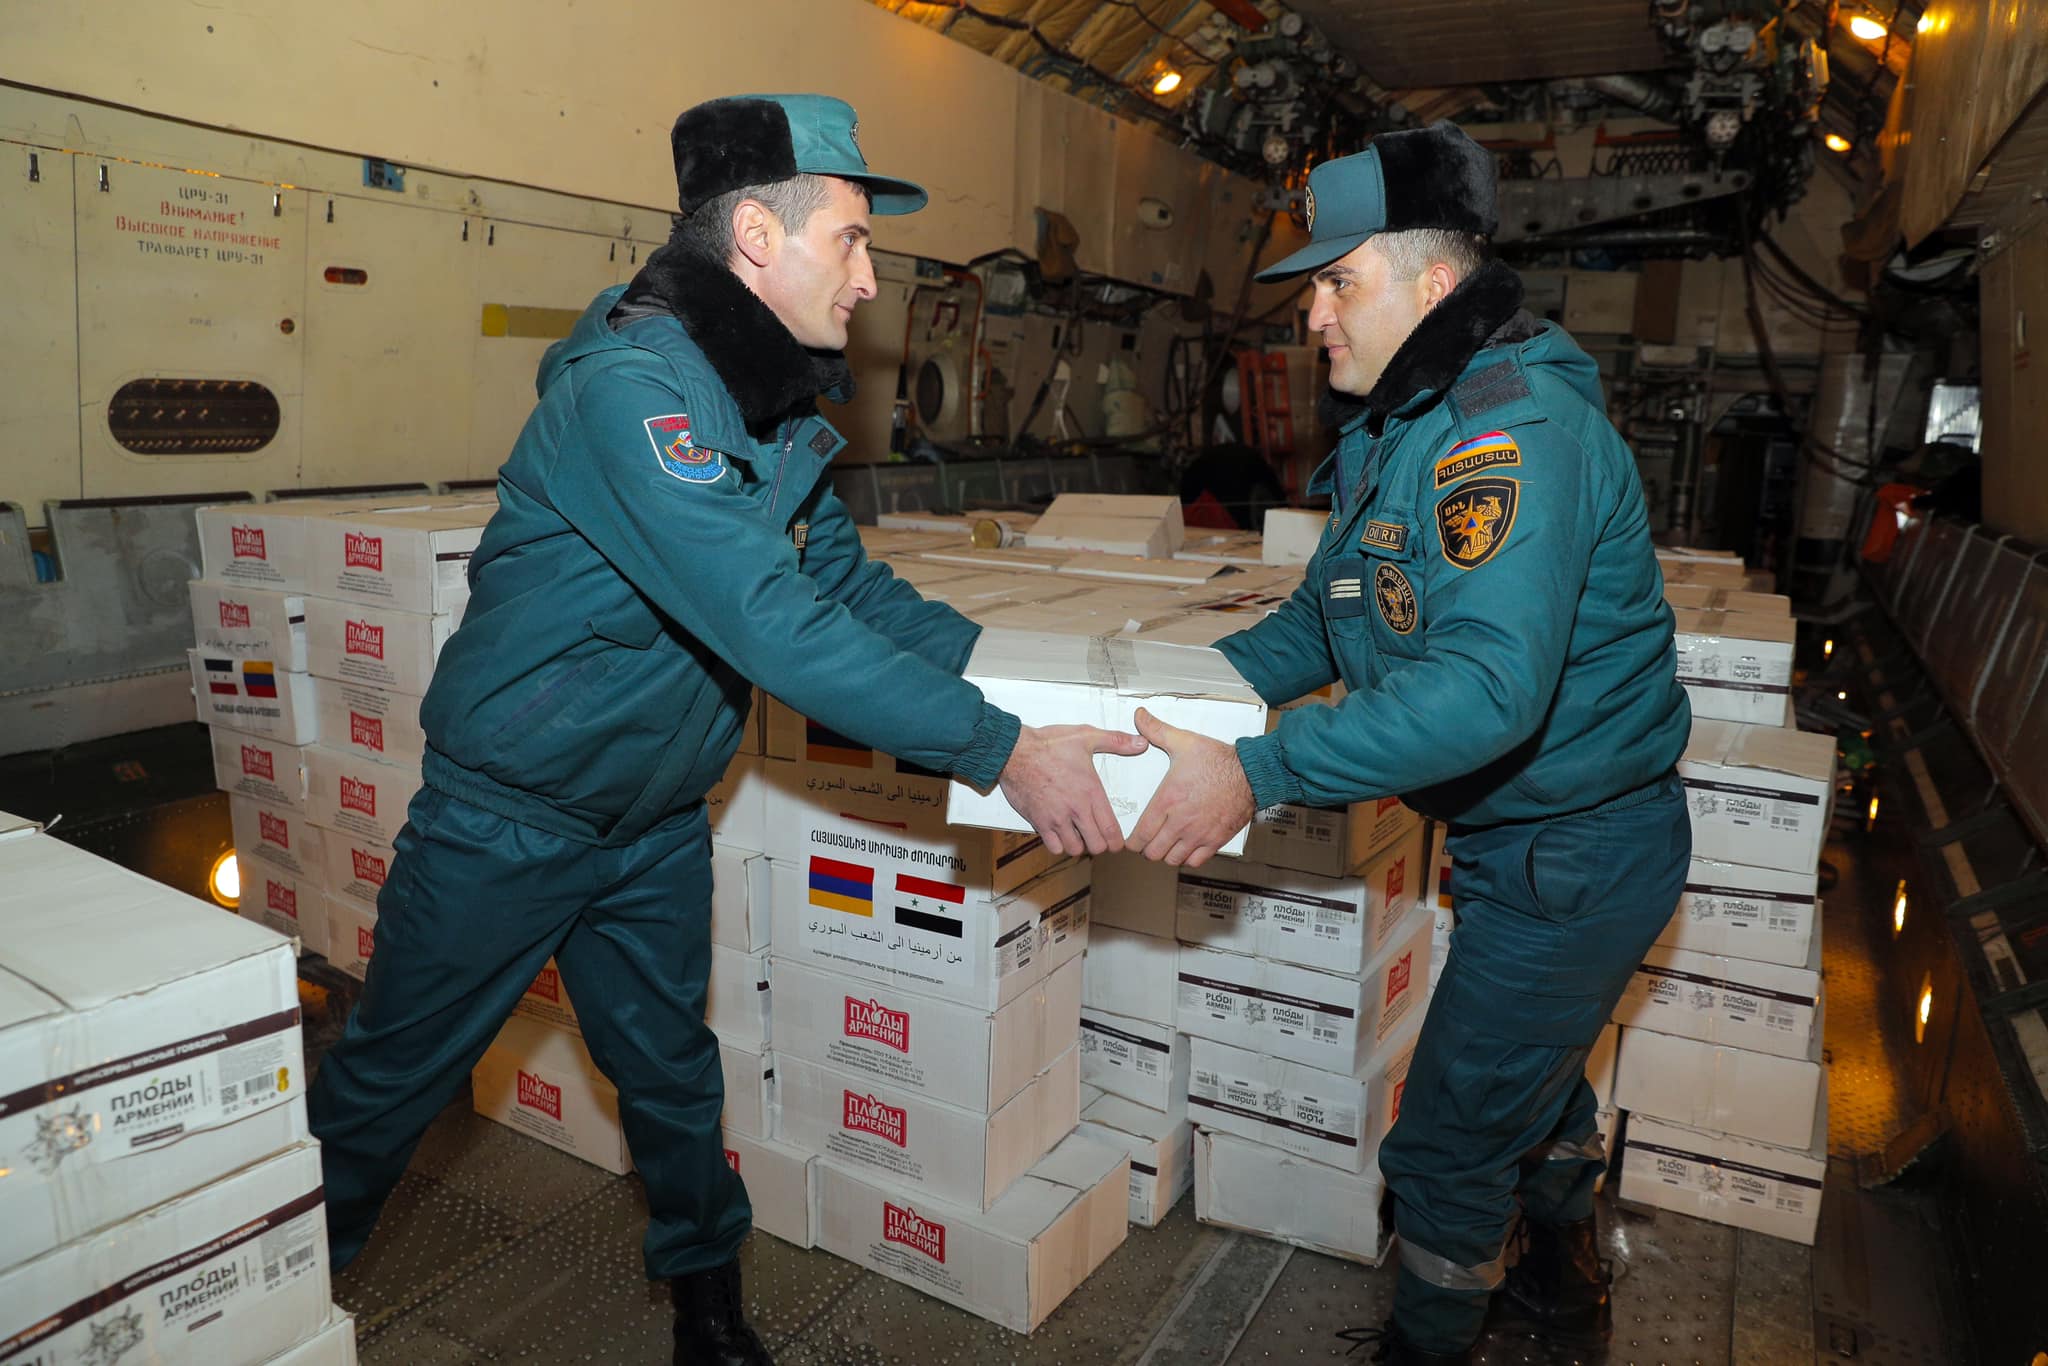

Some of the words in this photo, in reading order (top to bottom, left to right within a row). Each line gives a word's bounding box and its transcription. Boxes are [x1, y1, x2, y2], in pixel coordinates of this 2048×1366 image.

[137, 240, 208, 259] ТРАФАРЕТ
[1438, 451, 1516, 478] ՀԱՅԱՍՏԱՆ
[1264, 806, 1297, 819] ПЛОДЫ
[1273, 903, 1305, 917] ПЛОДЫ
[1273, 913, 1305, 924] АРМЕНИИ
[808, 921, 847, 936] السوري
[851, 931, 884, 944] الشعب
[946, 951, 963, 964] من
[850, 1001, 904, 1033] ПЛОДЫ
[1272, 1007, 1304, 1021] ПЛОДЫ
[848, 1019, 903, 1048] АРМЕНИИ
[110, 1074, 193, 1112] ПЛОДЫ
[113, 1092, 194, 1127] АРМЕНИИ
[848, 1095, 901, 1129] ПЛОДЫ
[847, 1112, 901, 1143] АРМЕНИИ
[888, 1208, 940, 1245] ПЛОДЫ
[887, 1225, 939, 1258] АРМЕНИИ
[159, 1261, 238, 1308] ПЛОДЫ
[162, 1277, 240, 1320] АРМЕНИИ
